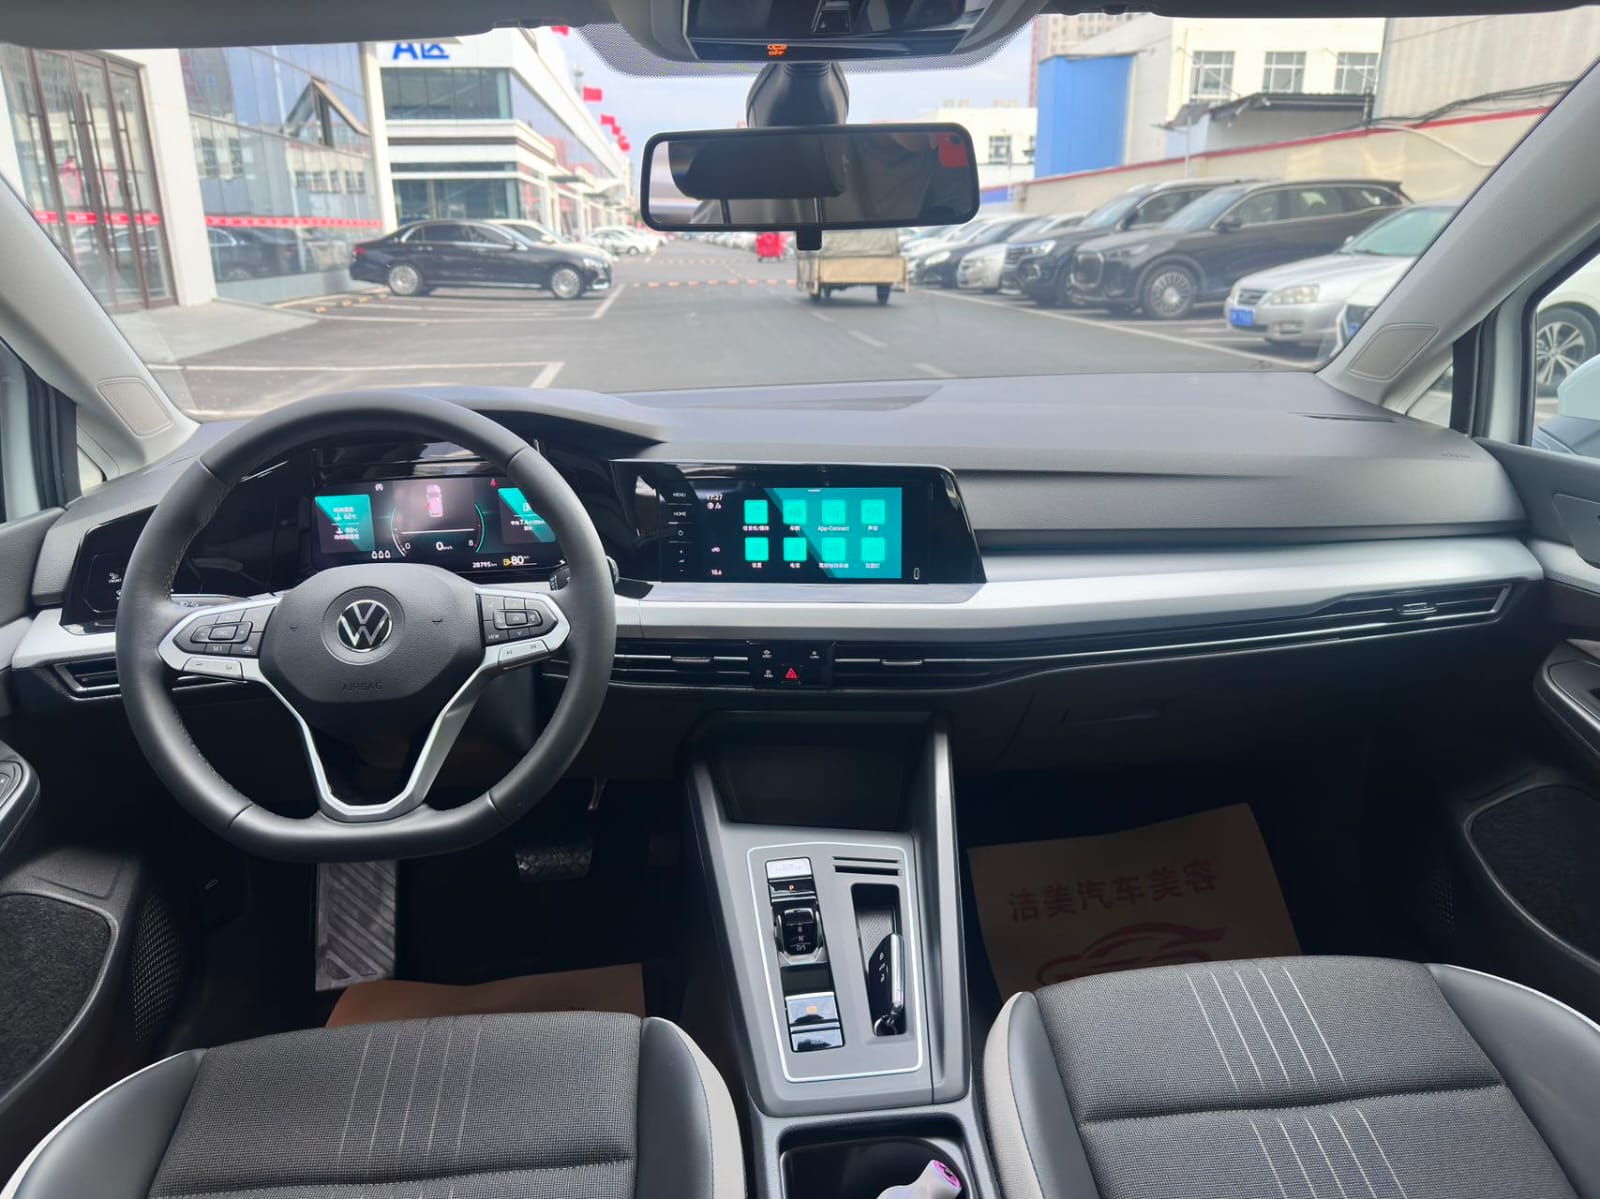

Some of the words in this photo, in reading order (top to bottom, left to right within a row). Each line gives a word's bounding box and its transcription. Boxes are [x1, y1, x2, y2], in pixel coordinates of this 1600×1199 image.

[511, 555, 524, 565] 80
[1007, 857, 1218, 924] 洁美汽车美容
